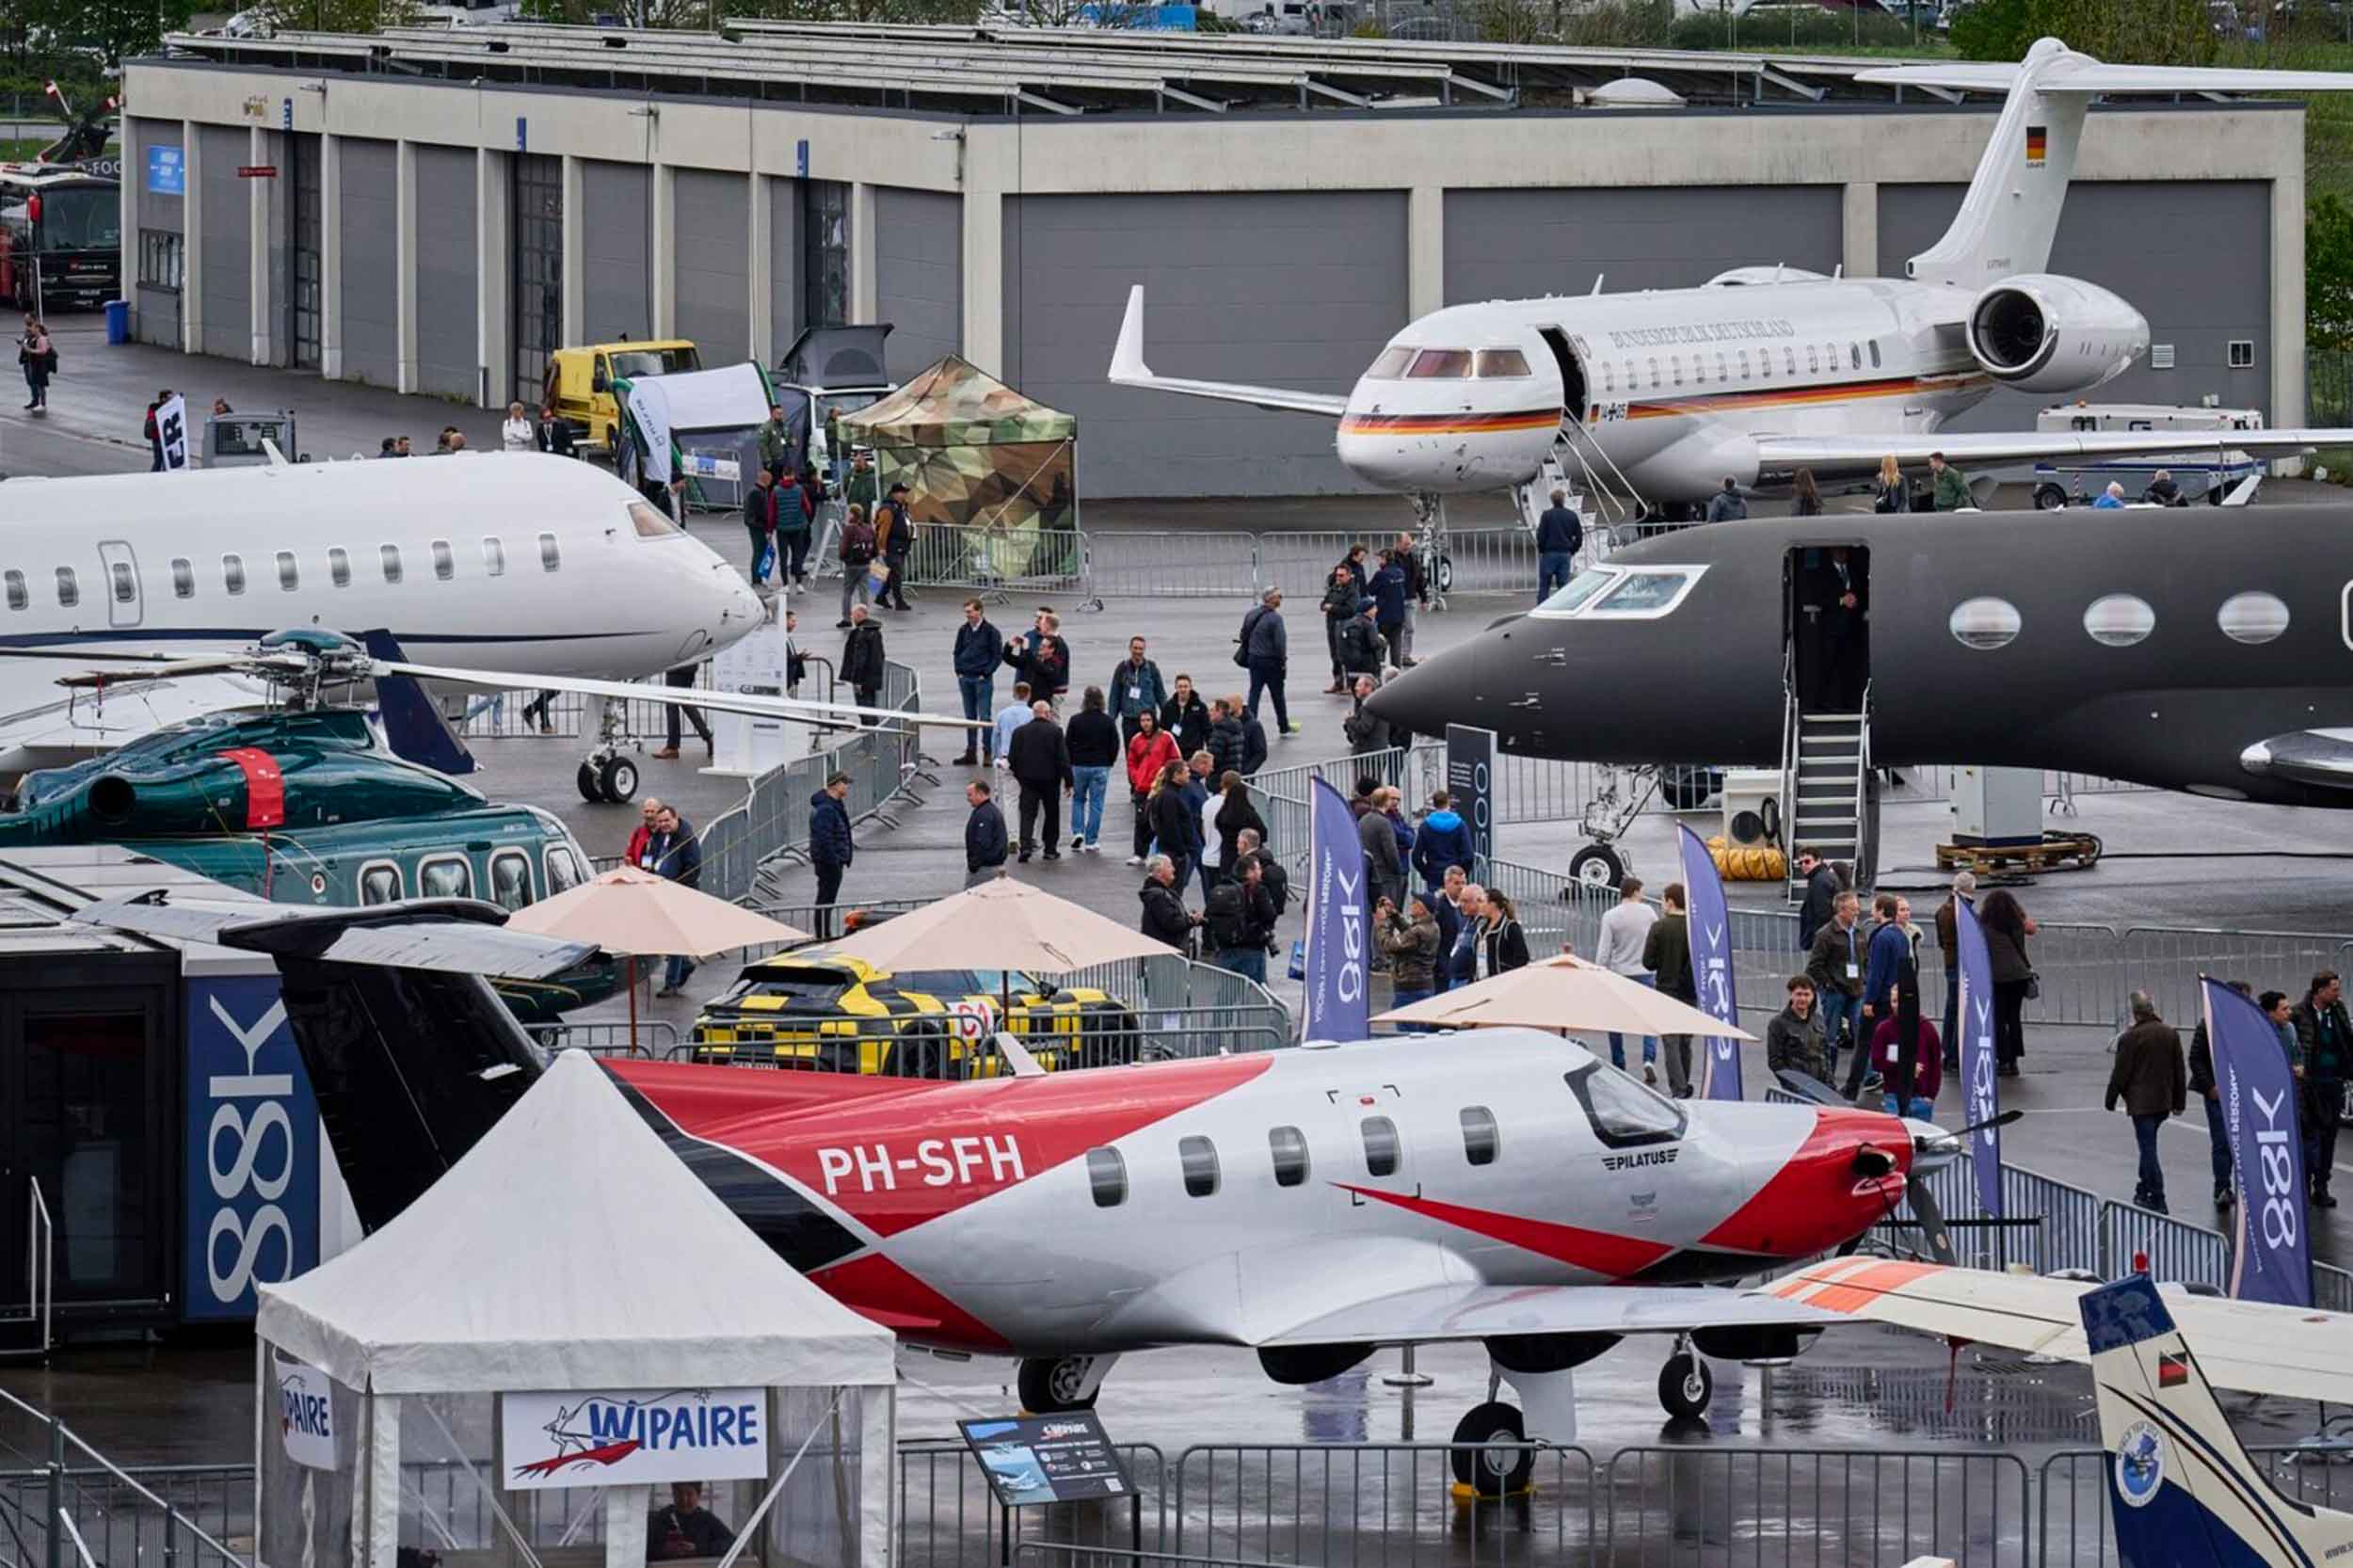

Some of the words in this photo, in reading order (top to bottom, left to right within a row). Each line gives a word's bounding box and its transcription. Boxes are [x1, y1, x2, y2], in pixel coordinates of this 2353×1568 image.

[817, 1134, 1025, 1195] PH-SFH
[1616, 1150, 1667, 1170] PILATUS
[588, 1400, 758, 1451] WIPAIRE
